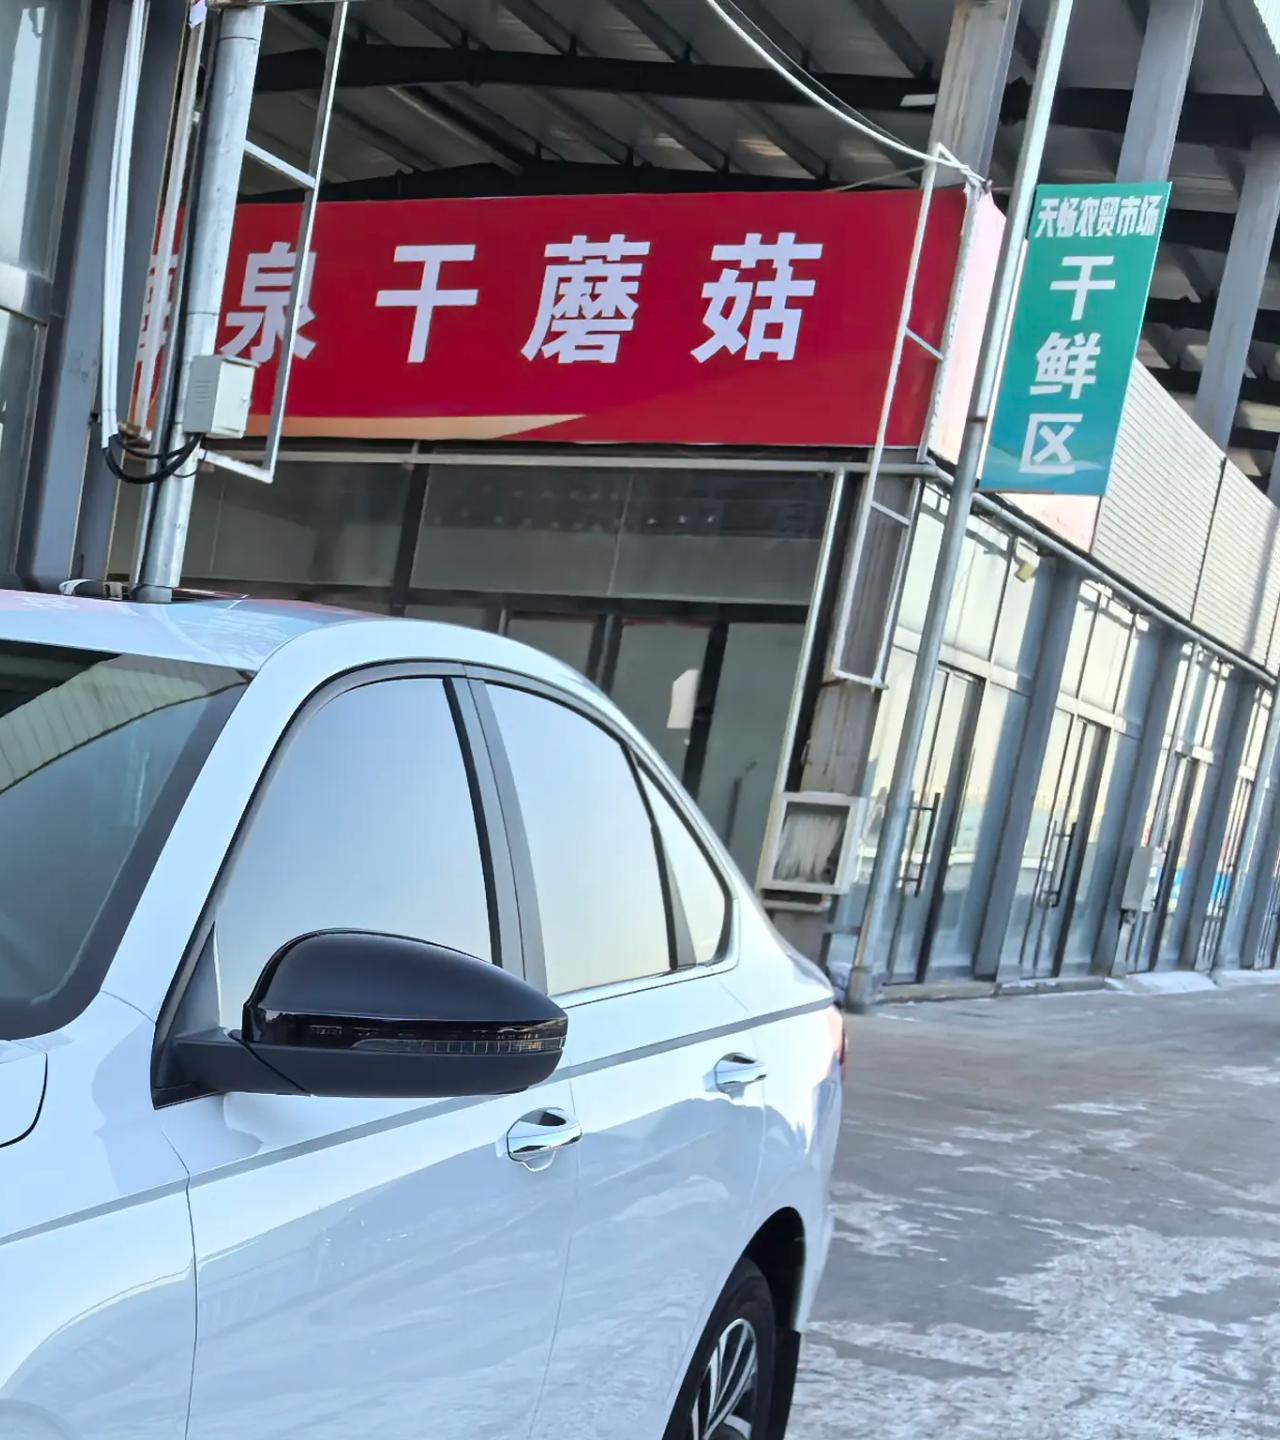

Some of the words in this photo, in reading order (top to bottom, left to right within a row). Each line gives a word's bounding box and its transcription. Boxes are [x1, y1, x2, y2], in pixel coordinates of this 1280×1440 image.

[1034, 195, 1164, 239] 天畅农贸市场
[1018, 255, 1116, 476] 干鲜区
